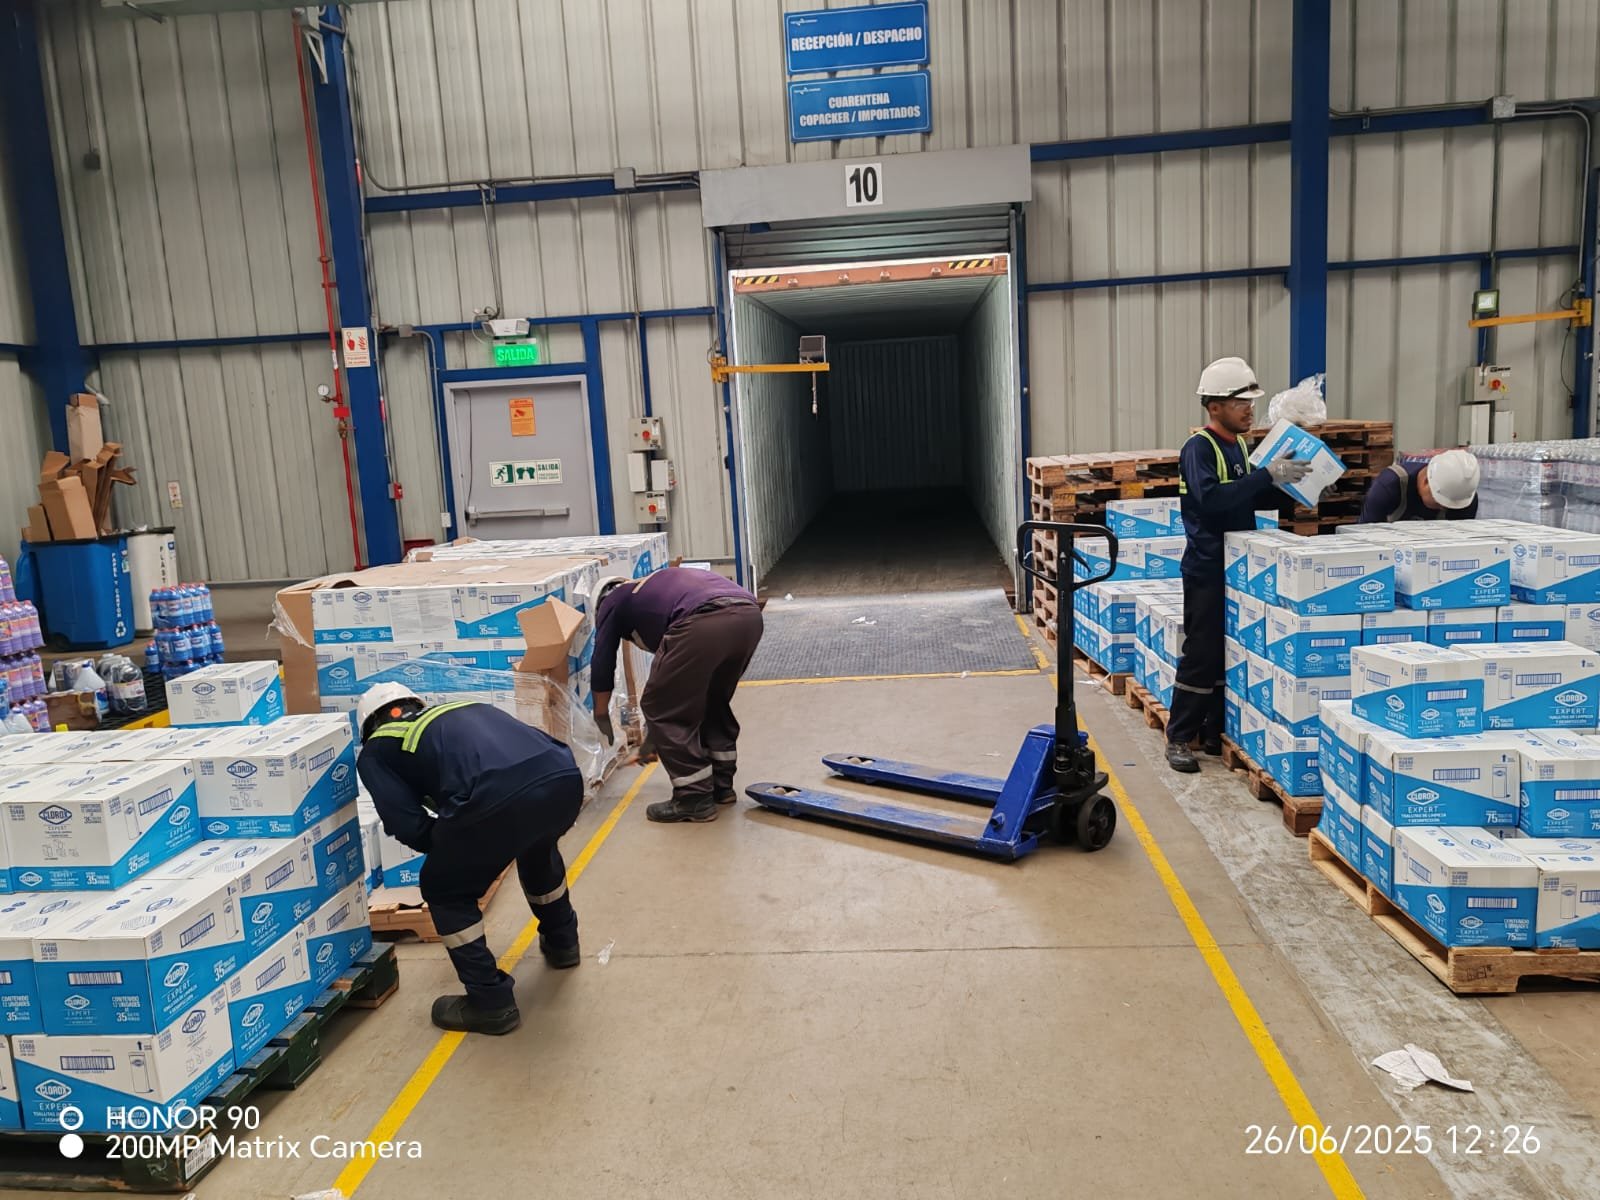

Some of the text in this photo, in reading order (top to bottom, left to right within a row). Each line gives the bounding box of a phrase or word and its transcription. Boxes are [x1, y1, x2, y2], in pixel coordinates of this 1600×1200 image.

[792, 31, 853, 51] RECEPCIÓN
[863, 27, 922, 44] DESPACHO
[828, 93, 890, 109] CUARENTENA
[800, 110, 850, 126] COPACKER
[858, 106, 920, 122] IMPORTADOS
[850, 166, 878, 203] 10
[497, 348, 534, 362] SALIDA
[538, 463, 558, 471] SALIDA
[1546, 594, 1555, 602] 75
[1421, 599, 1431, 608] 75
[1307, 605, 1316, 614] 75
[1458, 720, 1466, 728] 75
[1490, 719, 1500, 728] 75
[1302, 727, 1310, 735] 75
[231, 765, 254, 774] CLOROX
[1410, 792, 1436, 800] CLOROX
[42, 810, 68, 820] CLOROX
[1486, 814, 1498, 823] 75
[128, 859, 138, 874] 35
[86, 876, 96, 884] 35
[400, 872, 411, 882] 35
[1506, 932, 1516, 941] 75
[214, 966, 225, 982] 35
[167, 980, 190, 1002] EXPERT
[6, 1012, 16, 1021] 35
[116, 1012, 128, 1022] 35
[39, 1084, 69, 1096] CLOROX
